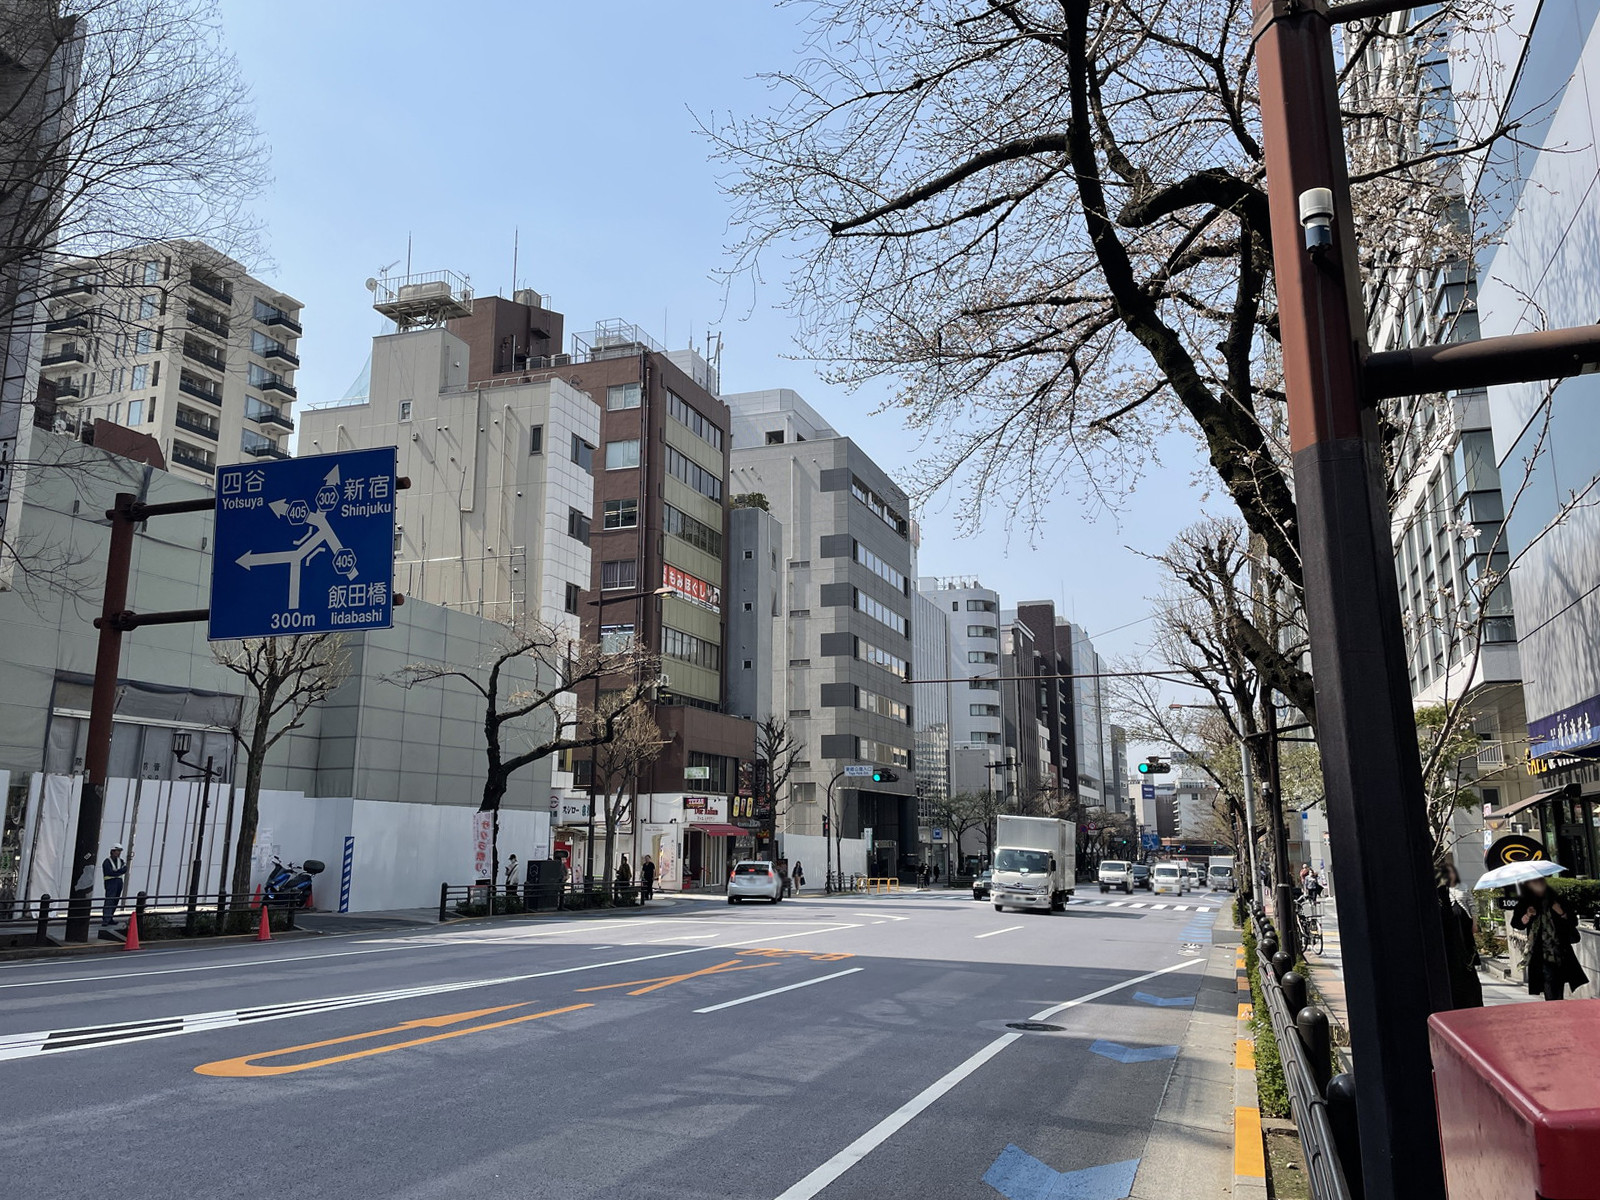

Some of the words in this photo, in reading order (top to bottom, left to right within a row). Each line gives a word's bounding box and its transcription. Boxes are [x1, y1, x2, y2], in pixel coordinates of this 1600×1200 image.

[222, 470, 265, 495] 四谷
[343, 475, 390, 501] 新宿
[222, 496, 264, 511] Yotsuya
[318, 492, 336, 505] 302
[289, 505, 307, 519] 405
[341, 502, 391, 518] Shinjuku
[335, 554, 353, 568] 405
[328, 582, 388, 609] 飯田橋
[270, 612, 316, 629] 300m
[331, 609, 383, 625] Iidabashi
[562, 806, 580, 814] スシロー
